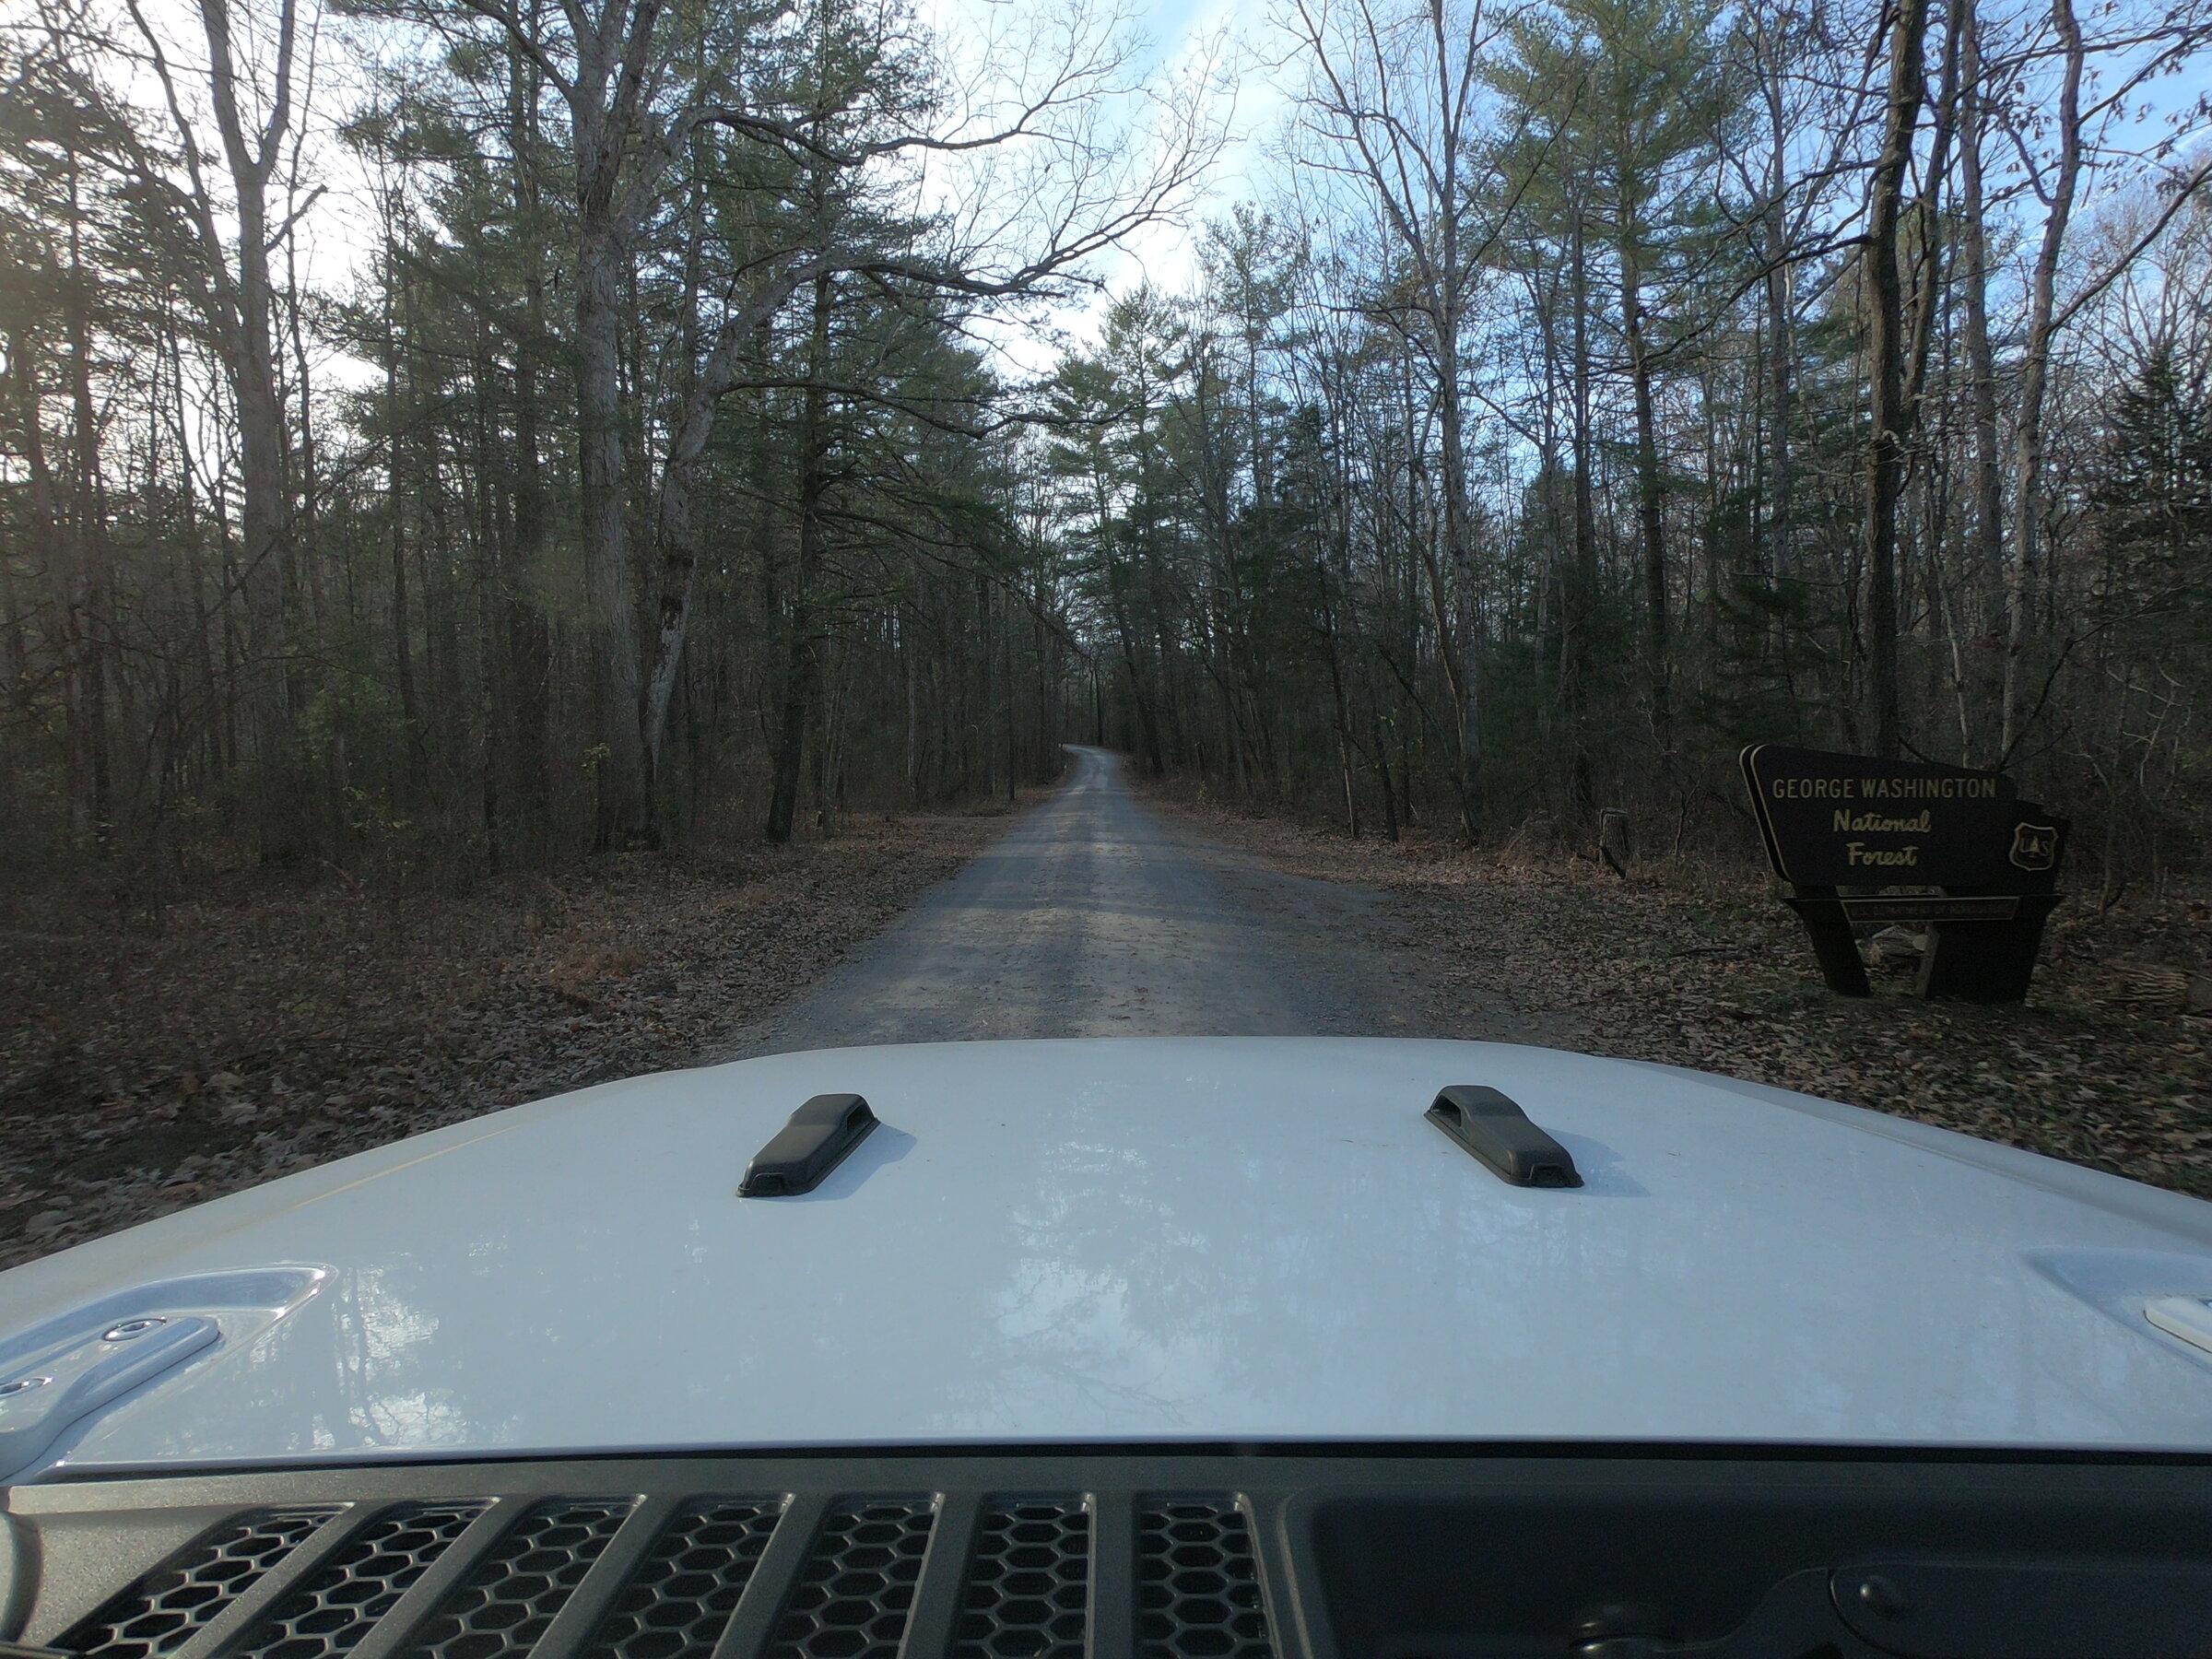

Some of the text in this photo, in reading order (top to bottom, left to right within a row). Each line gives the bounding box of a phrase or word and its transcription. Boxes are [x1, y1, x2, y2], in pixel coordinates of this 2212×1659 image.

[1773, 778, 1995, 799] GEORGE WASHINGTON
[1832, 808, 1932, 832] National
[1845, 841, 1920, 866] Forest
